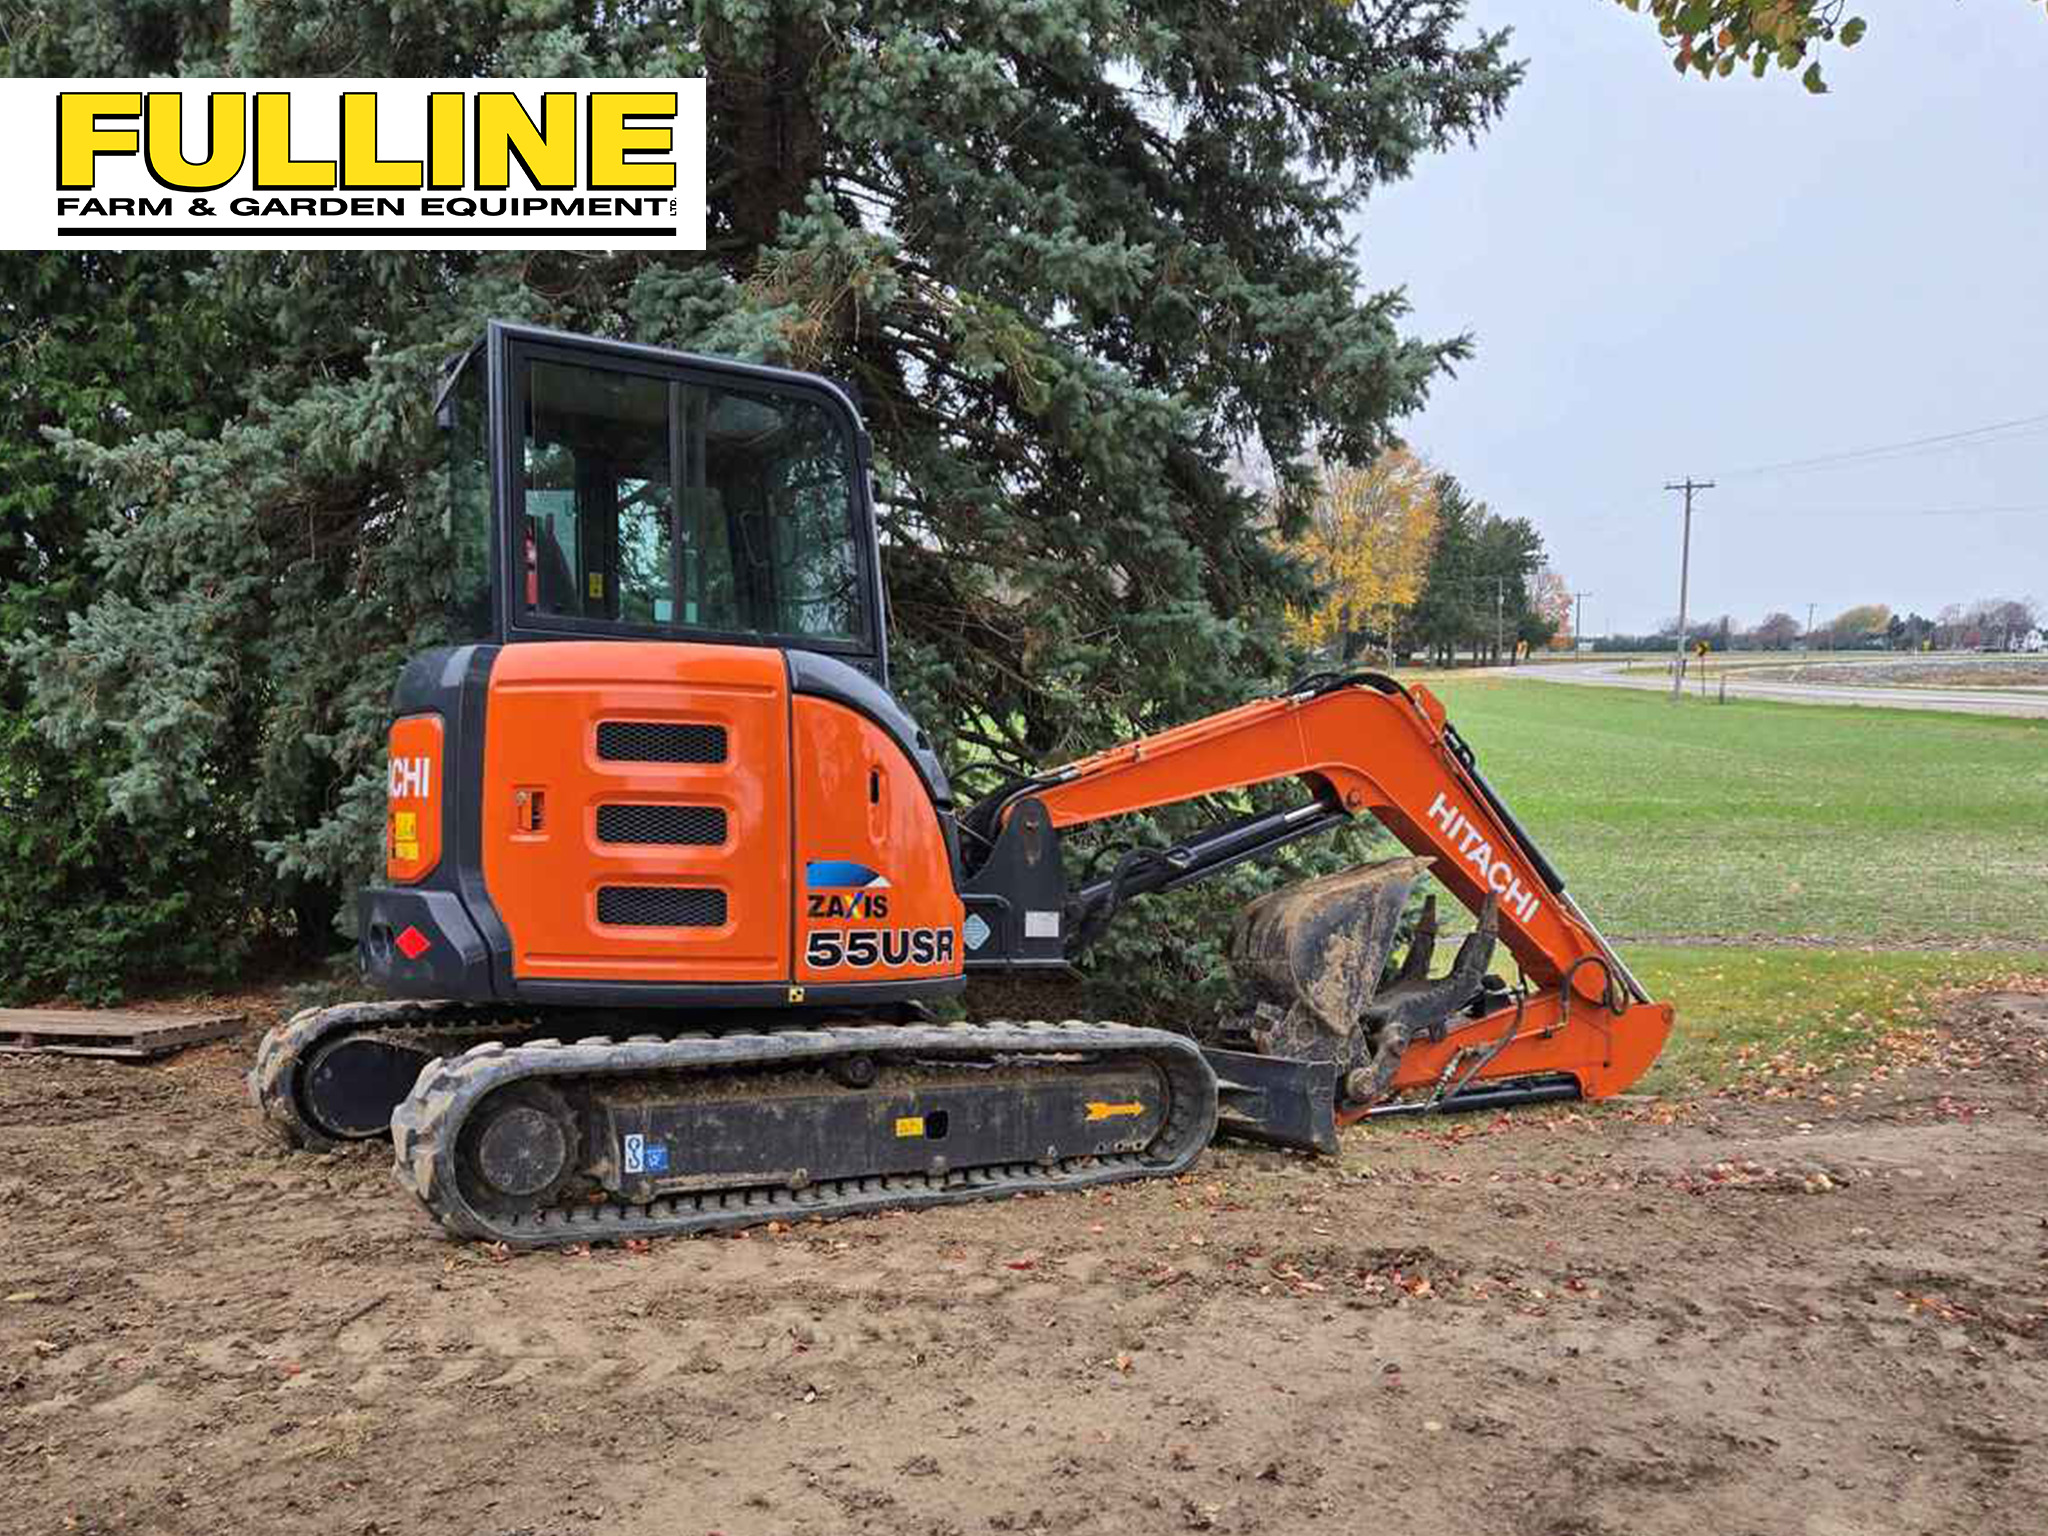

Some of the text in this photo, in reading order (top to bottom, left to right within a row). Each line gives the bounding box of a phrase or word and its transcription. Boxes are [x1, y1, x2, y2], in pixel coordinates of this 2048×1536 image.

[387, 757, 430, 797] CHI
[1428, 792, 1541, 922] HITACHI
[807, 891, 889, 919] ZAXIS
[805, 927, 954, 969] 55USR
